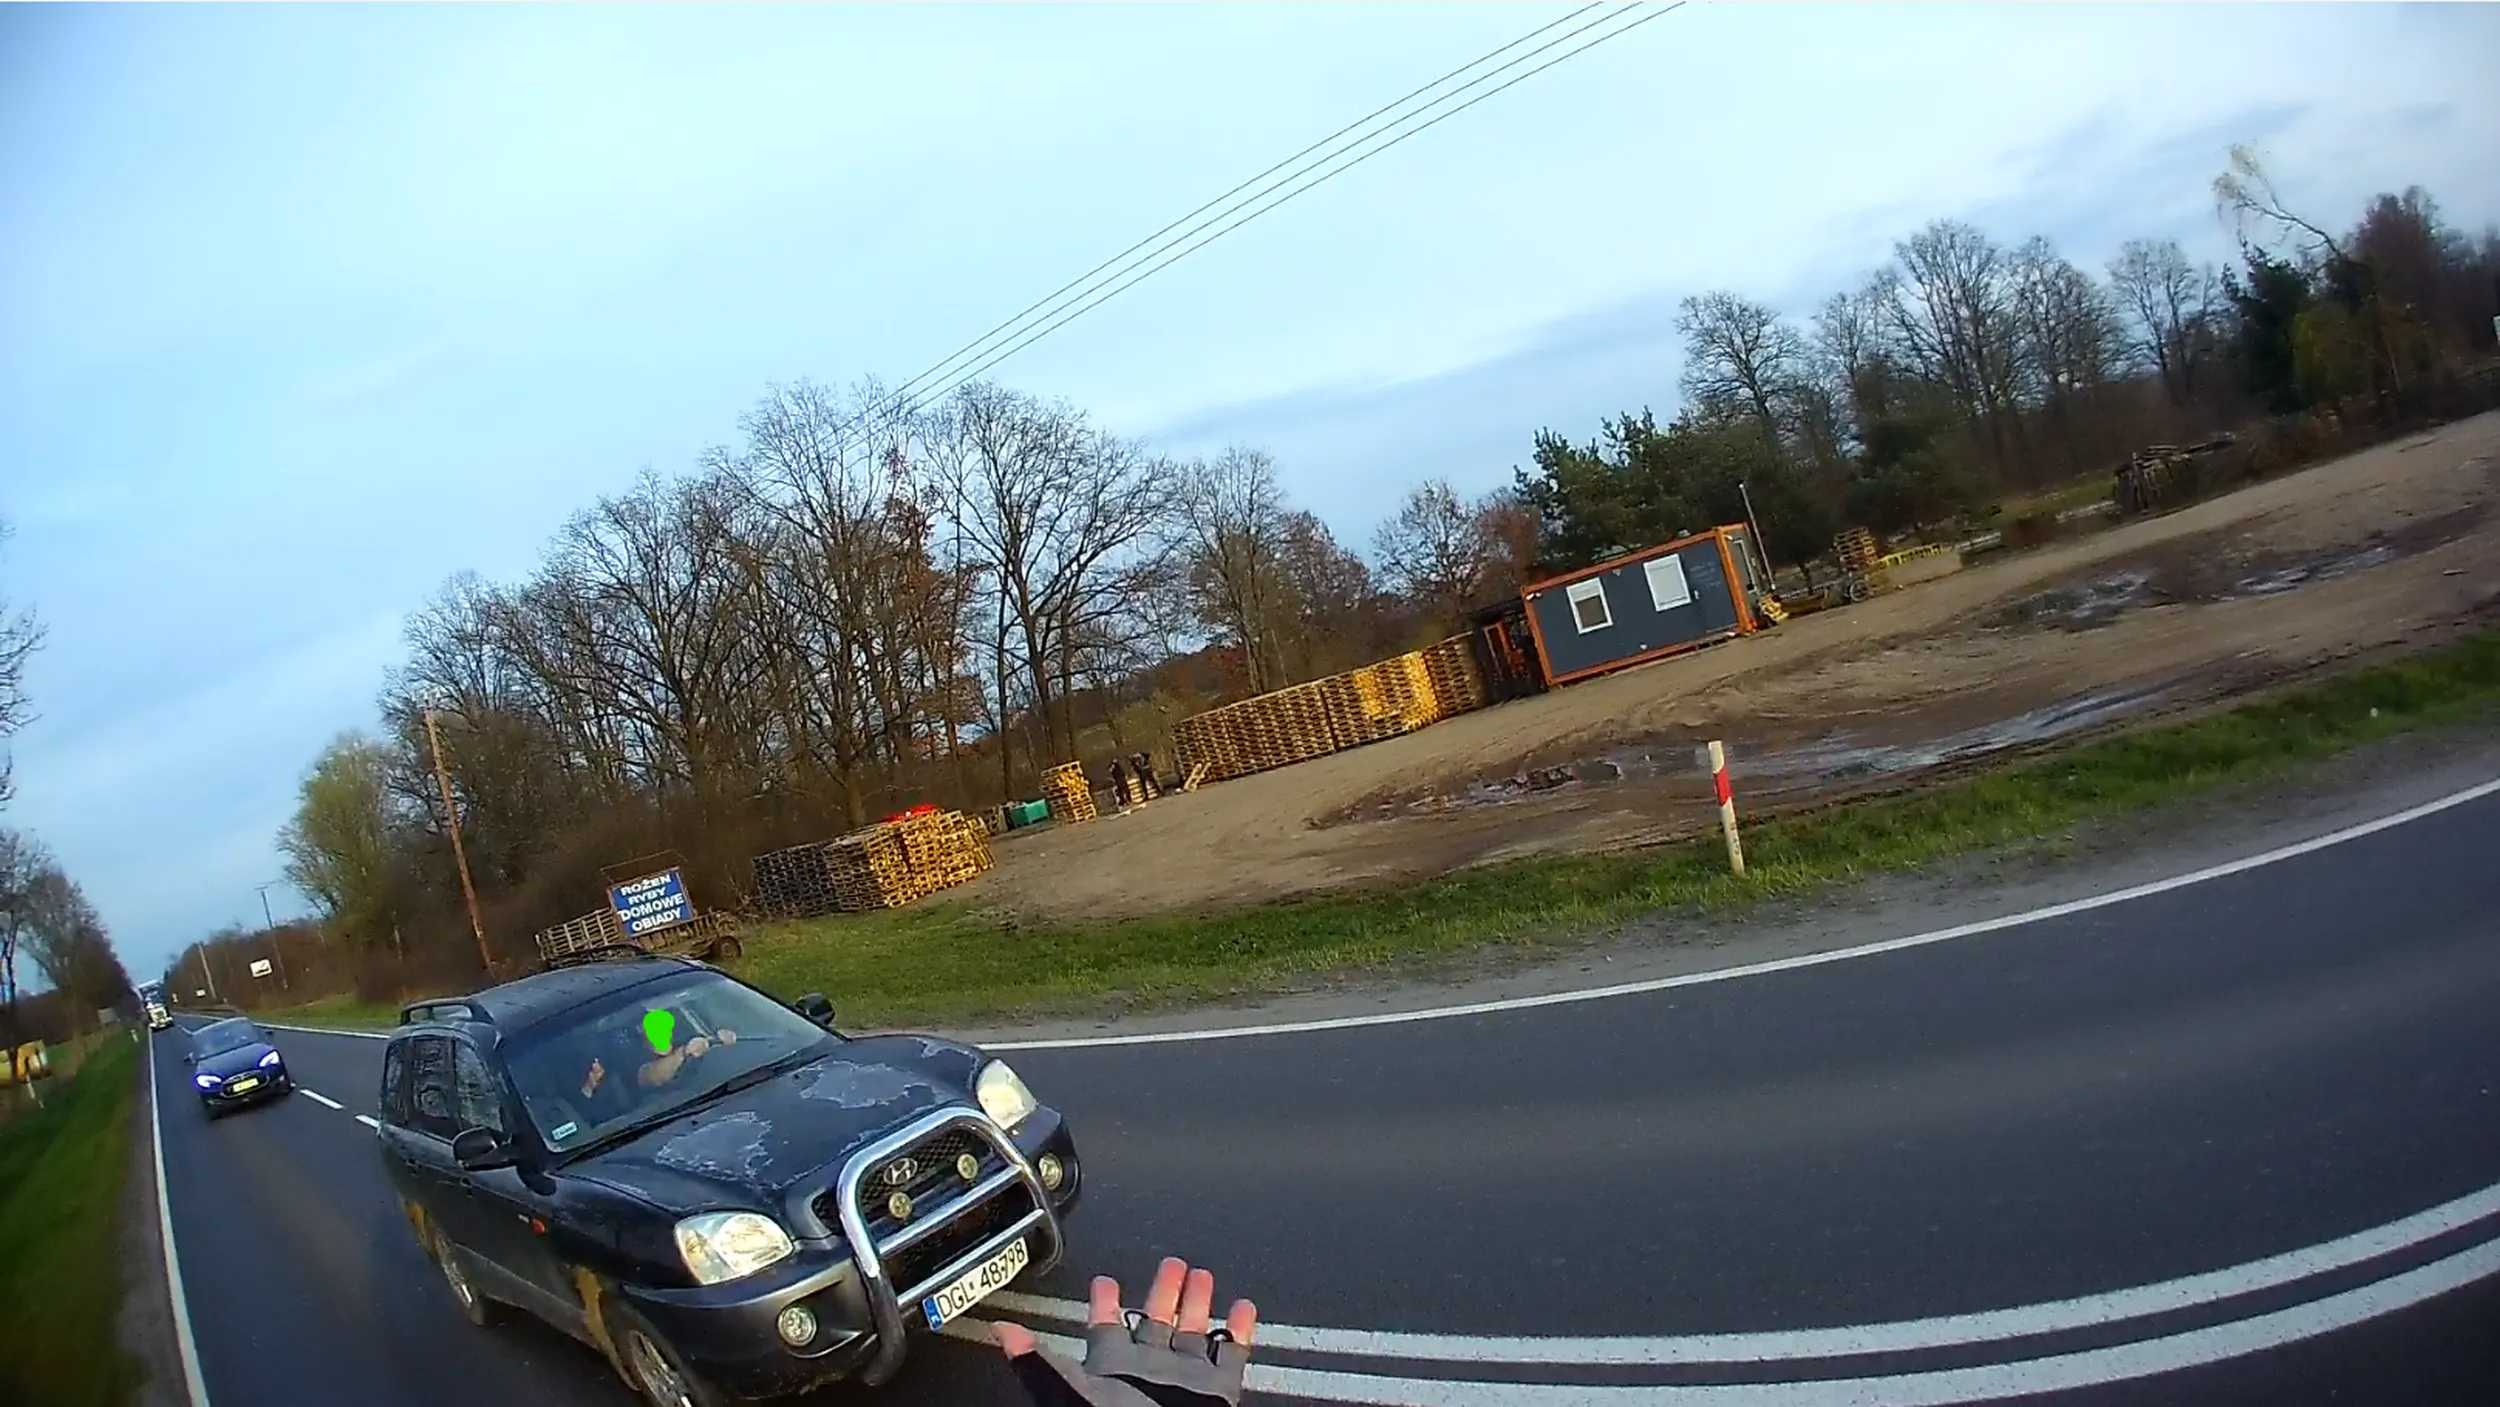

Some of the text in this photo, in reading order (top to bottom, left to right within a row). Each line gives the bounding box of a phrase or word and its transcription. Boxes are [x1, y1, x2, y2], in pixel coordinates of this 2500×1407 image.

[617, 893, 685, 922] DOMOWE
[627, 887, 667, 905] RYBY
[631, 908, 682, 932] OBIADY
[936, 1281, 977, 1319] DGL
